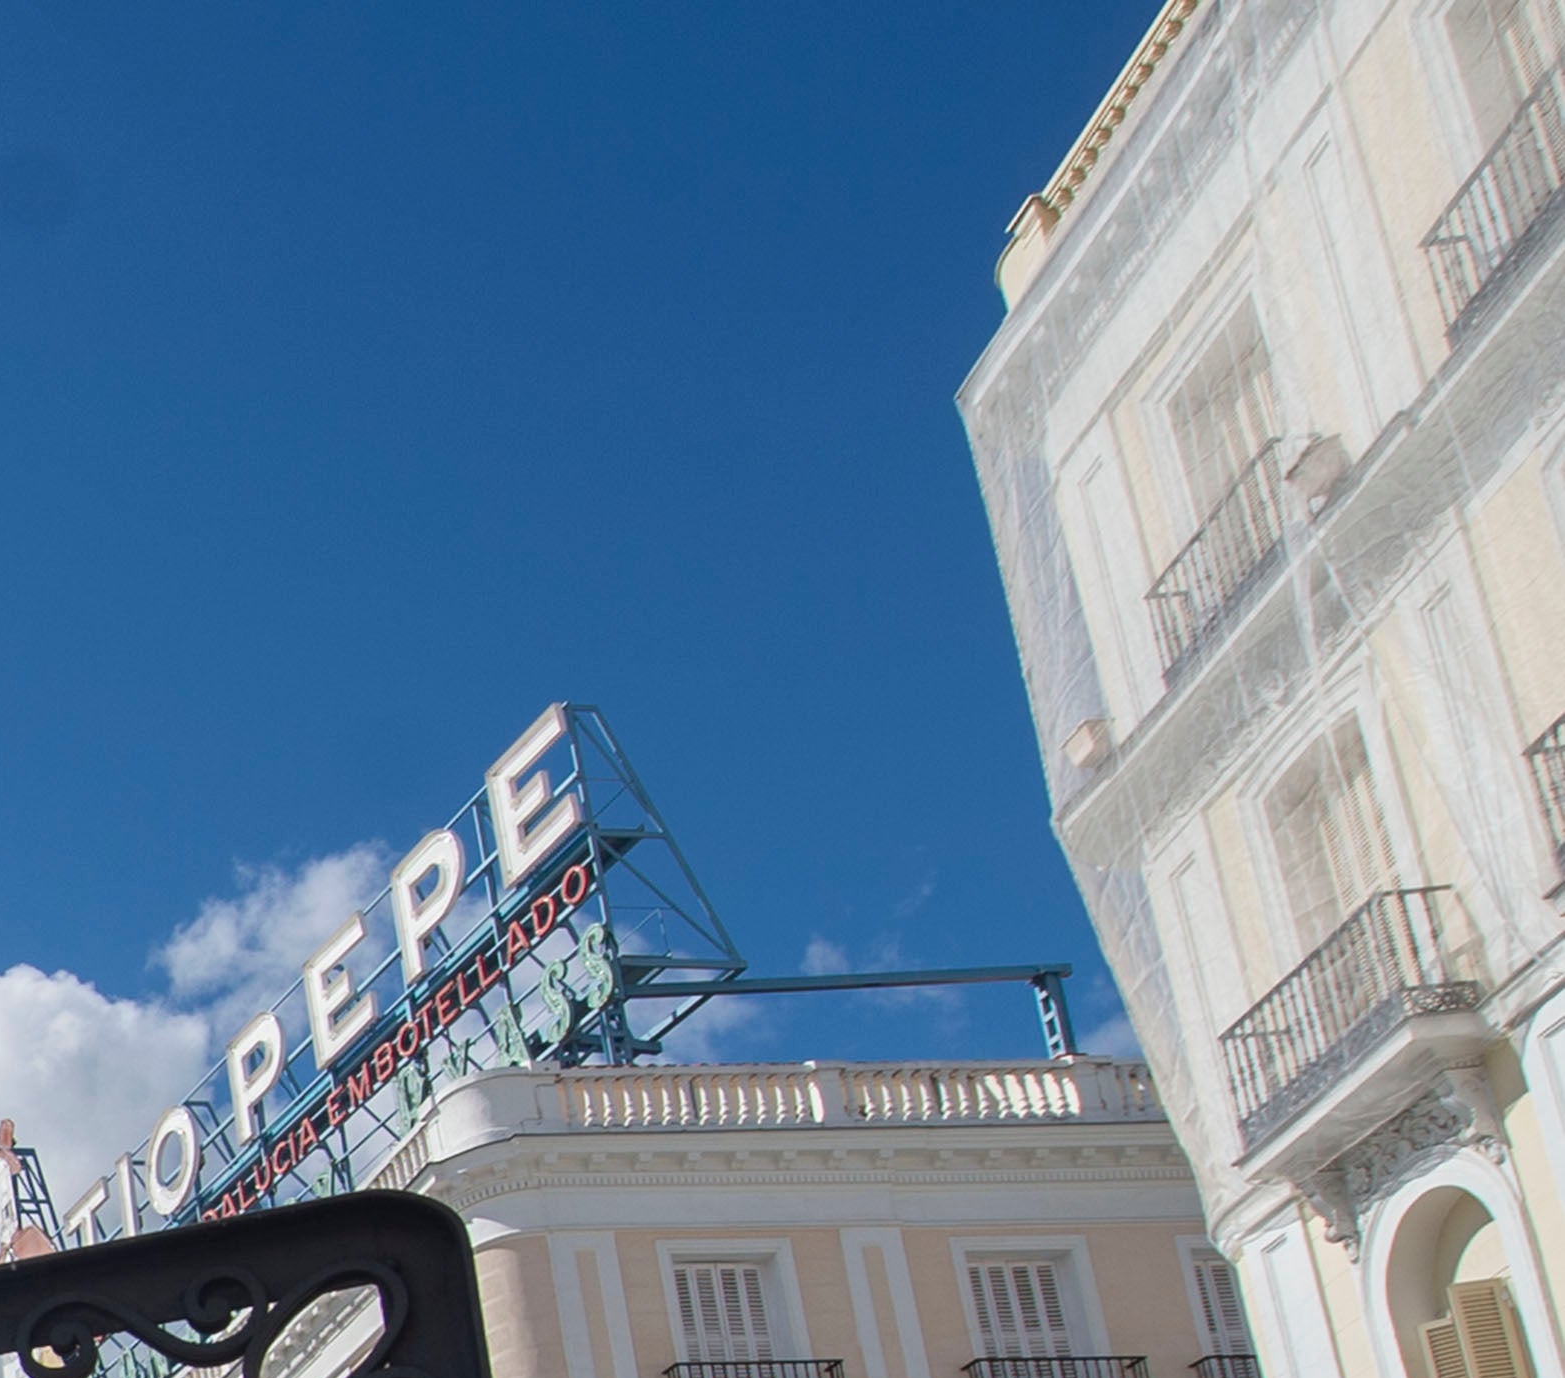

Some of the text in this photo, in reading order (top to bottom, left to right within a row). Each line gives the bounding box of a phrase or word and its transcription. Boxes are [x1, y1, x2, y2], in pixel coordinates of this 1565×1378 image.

[62, 701, 582, 1246] TIO PEPE
[327, 865, 589, 1127] EMBOTELLADO
